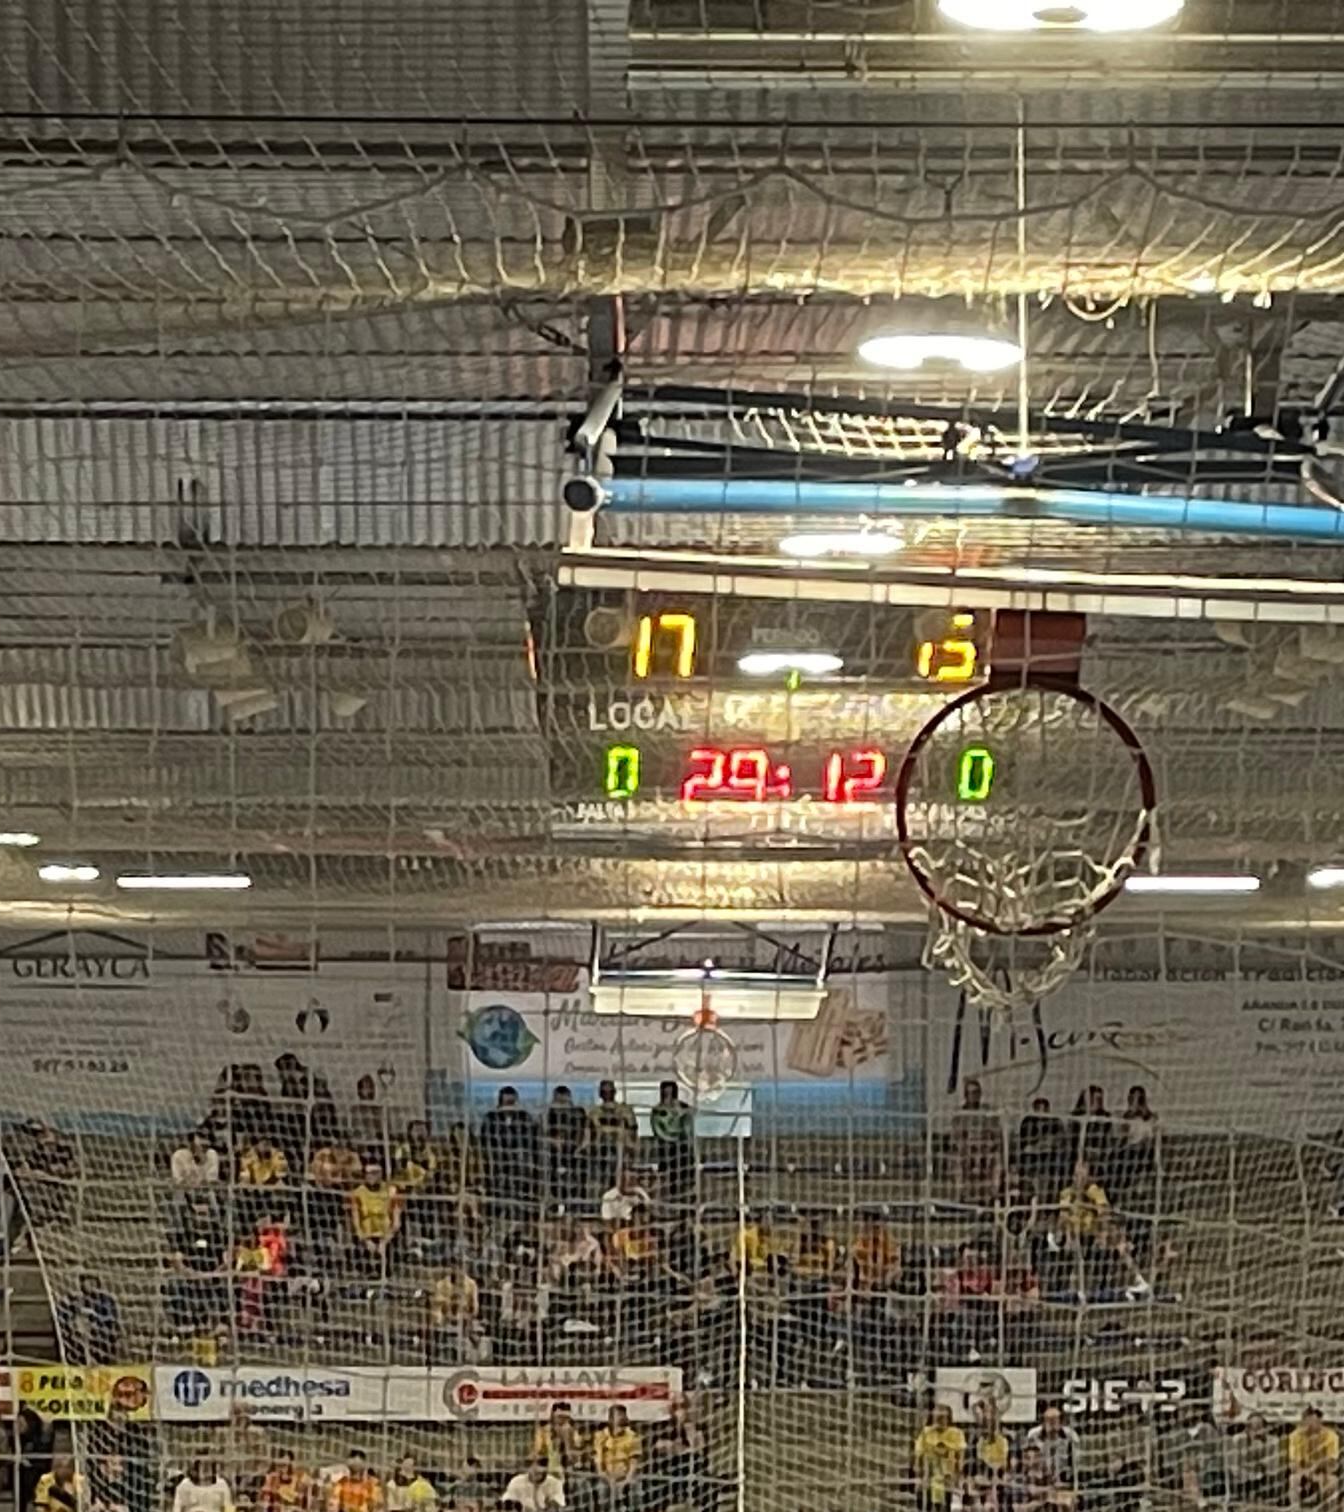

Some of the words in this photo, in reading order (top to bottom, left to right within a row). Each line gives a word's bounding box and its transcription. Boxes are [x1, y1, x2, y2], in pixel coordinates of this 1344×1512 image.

[634, 612, 696, 677] 17
[588, 700, 696, 731] LOCAL
[606, 745, 640, 798] 0
[682, 749, 886, 804] 29:12
[959, 748, 994, 800] 0
[219, 1376, 350, 1398] medhesa
